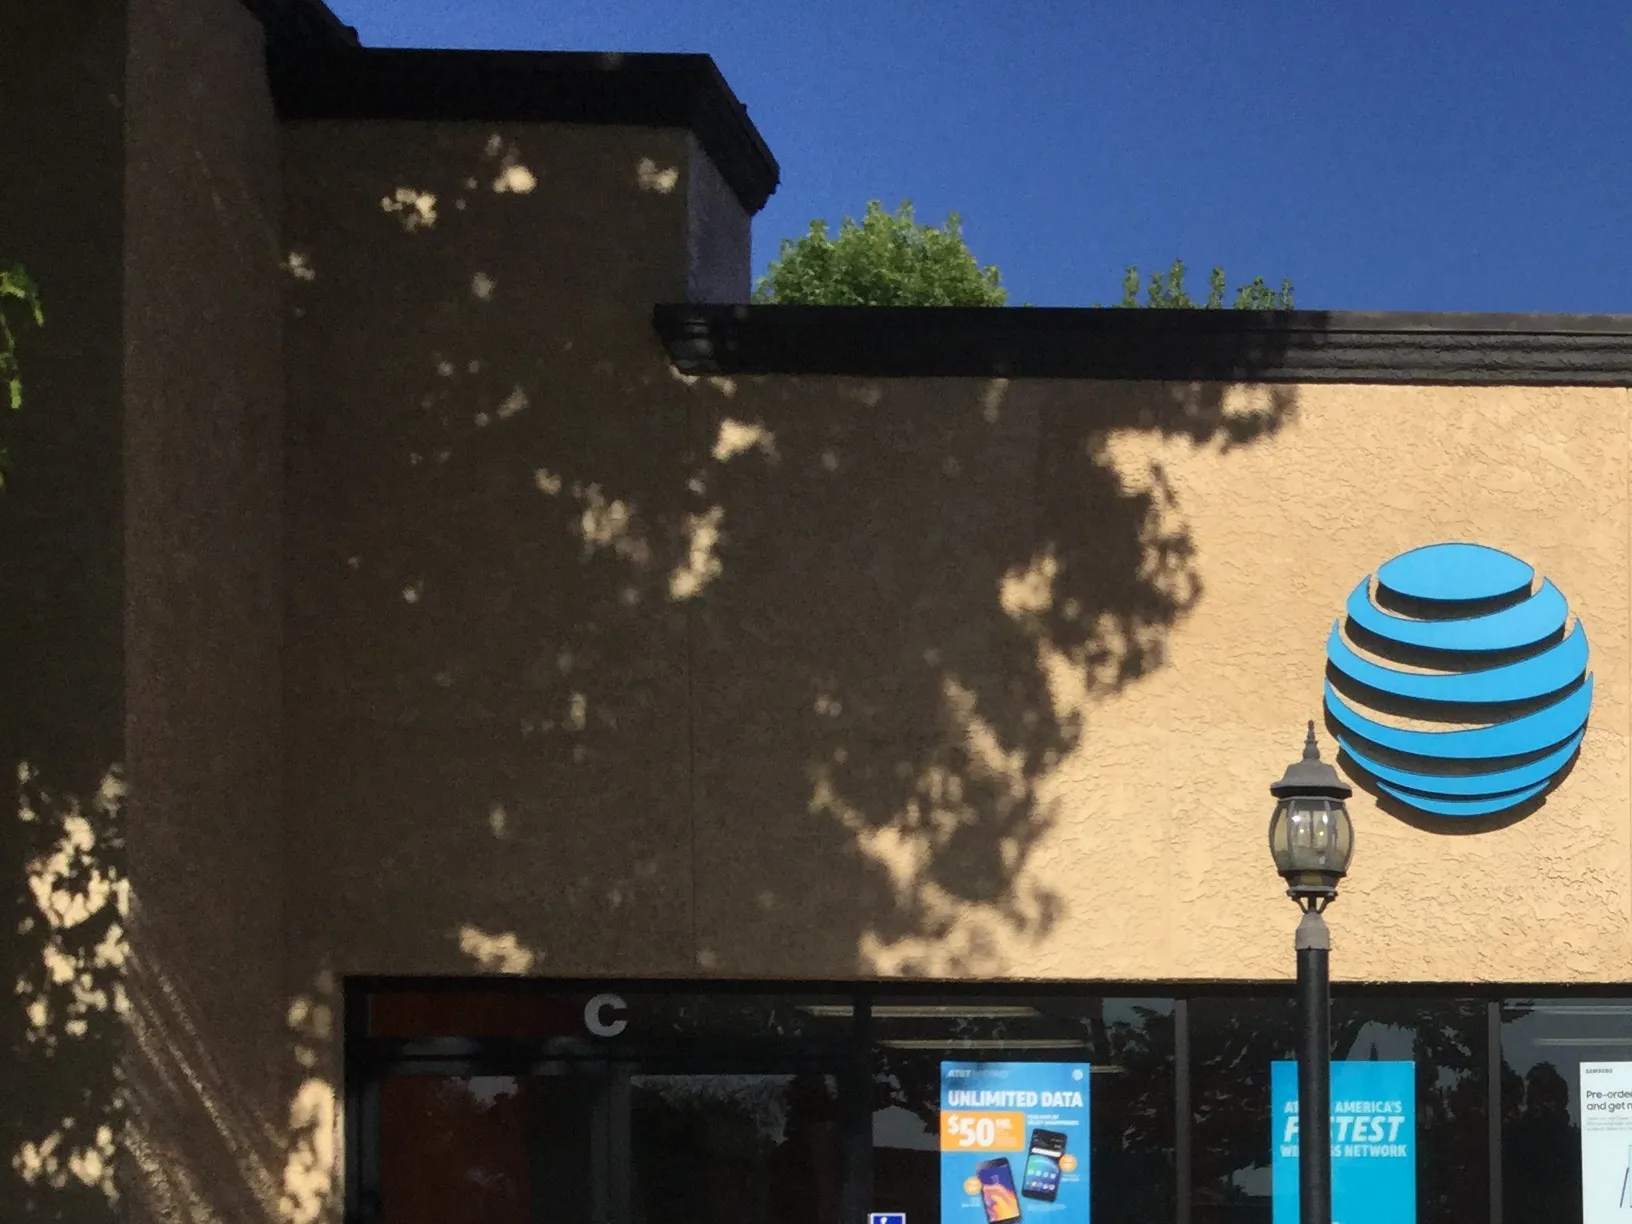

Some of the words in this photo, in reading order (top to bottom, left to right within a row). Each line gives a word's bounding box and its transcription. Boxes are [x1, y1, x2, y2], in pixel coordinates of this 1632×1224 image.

[584, 993, 628, 1037] C
[948, 1090, 1038, 1107] UNLIMITED
[1041, 1091, 1083, 1108] DATA
[1335, 1101, 1402, 1113] AMERICA'S
[1586, 1102, 1607, 1111] and
[1608, 1102, 1625, 1113] get
[947, 1114, 995, 1147] $50
[1283, 1116, 1405, 1143] FTEST
[1344, 1145, 1408, 1157] NETWORK
